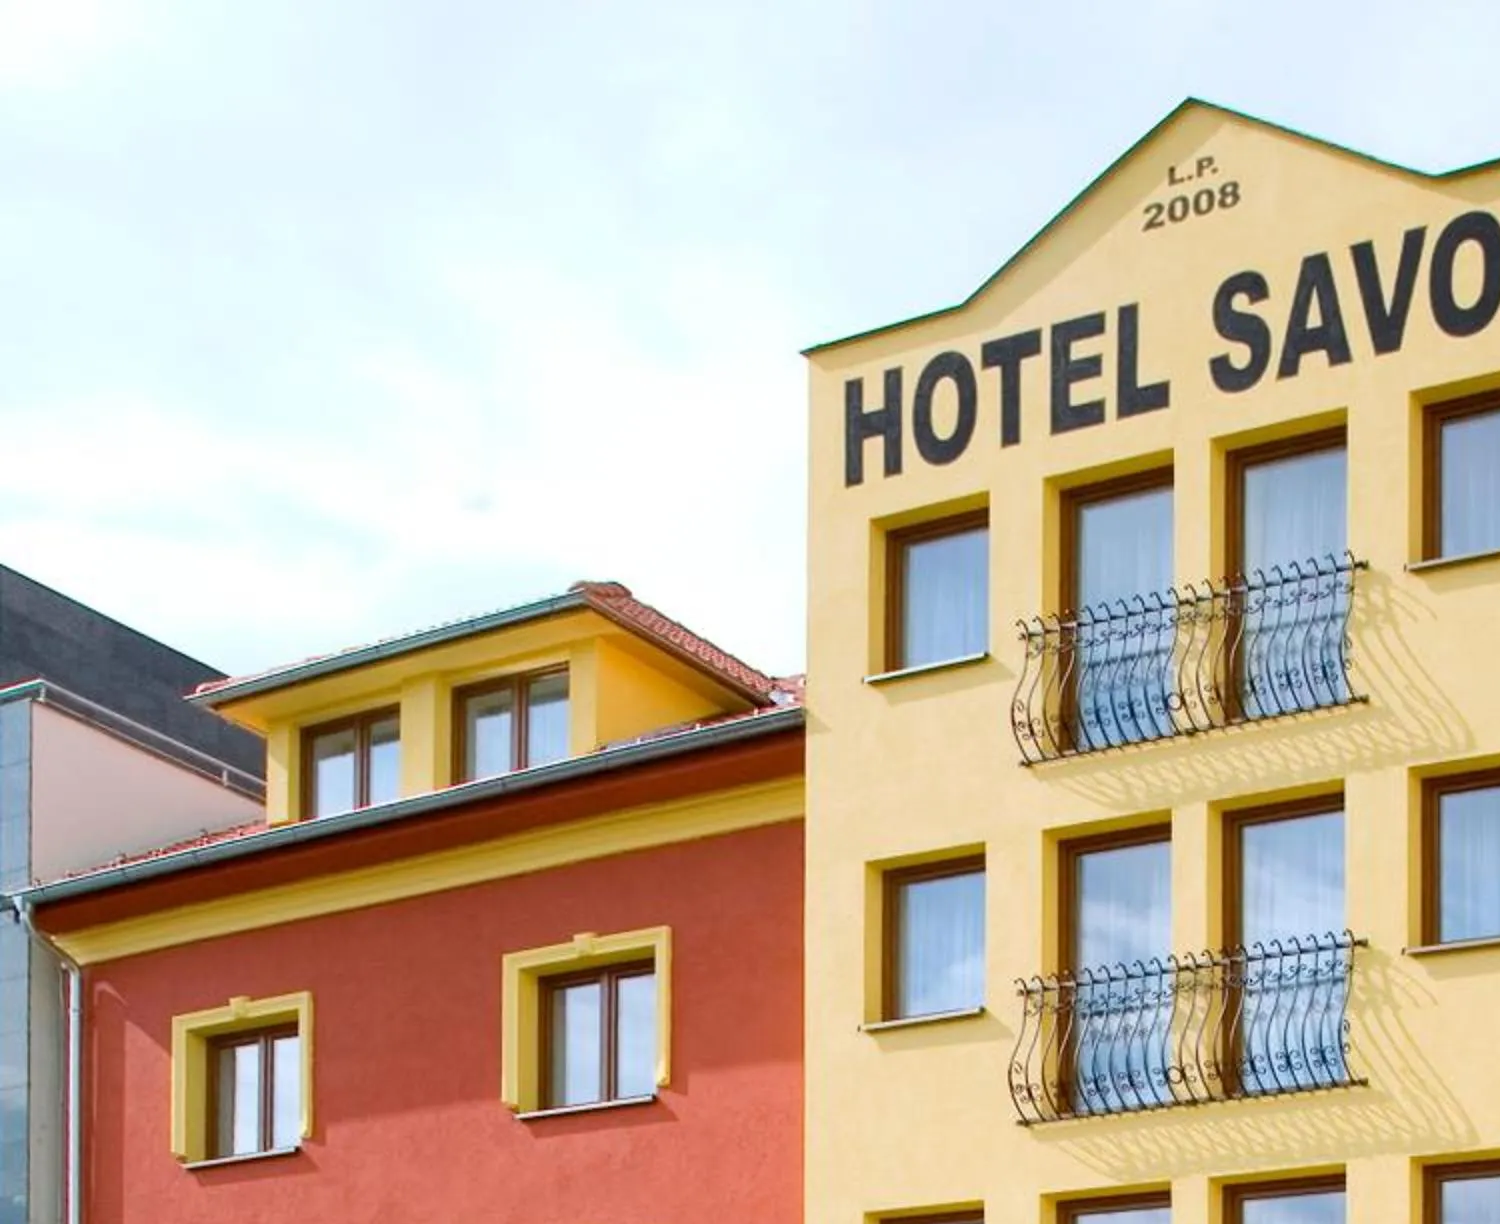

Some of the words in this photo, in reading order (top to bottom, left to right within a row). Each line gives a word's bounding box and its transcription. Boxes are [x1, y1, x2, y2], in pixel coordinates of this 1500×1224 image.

[1168, 156, 1219, 187] L.P.
[1142, 181, 1241, 233] 2008
[844, 303, 1171, 488] HOTEL
